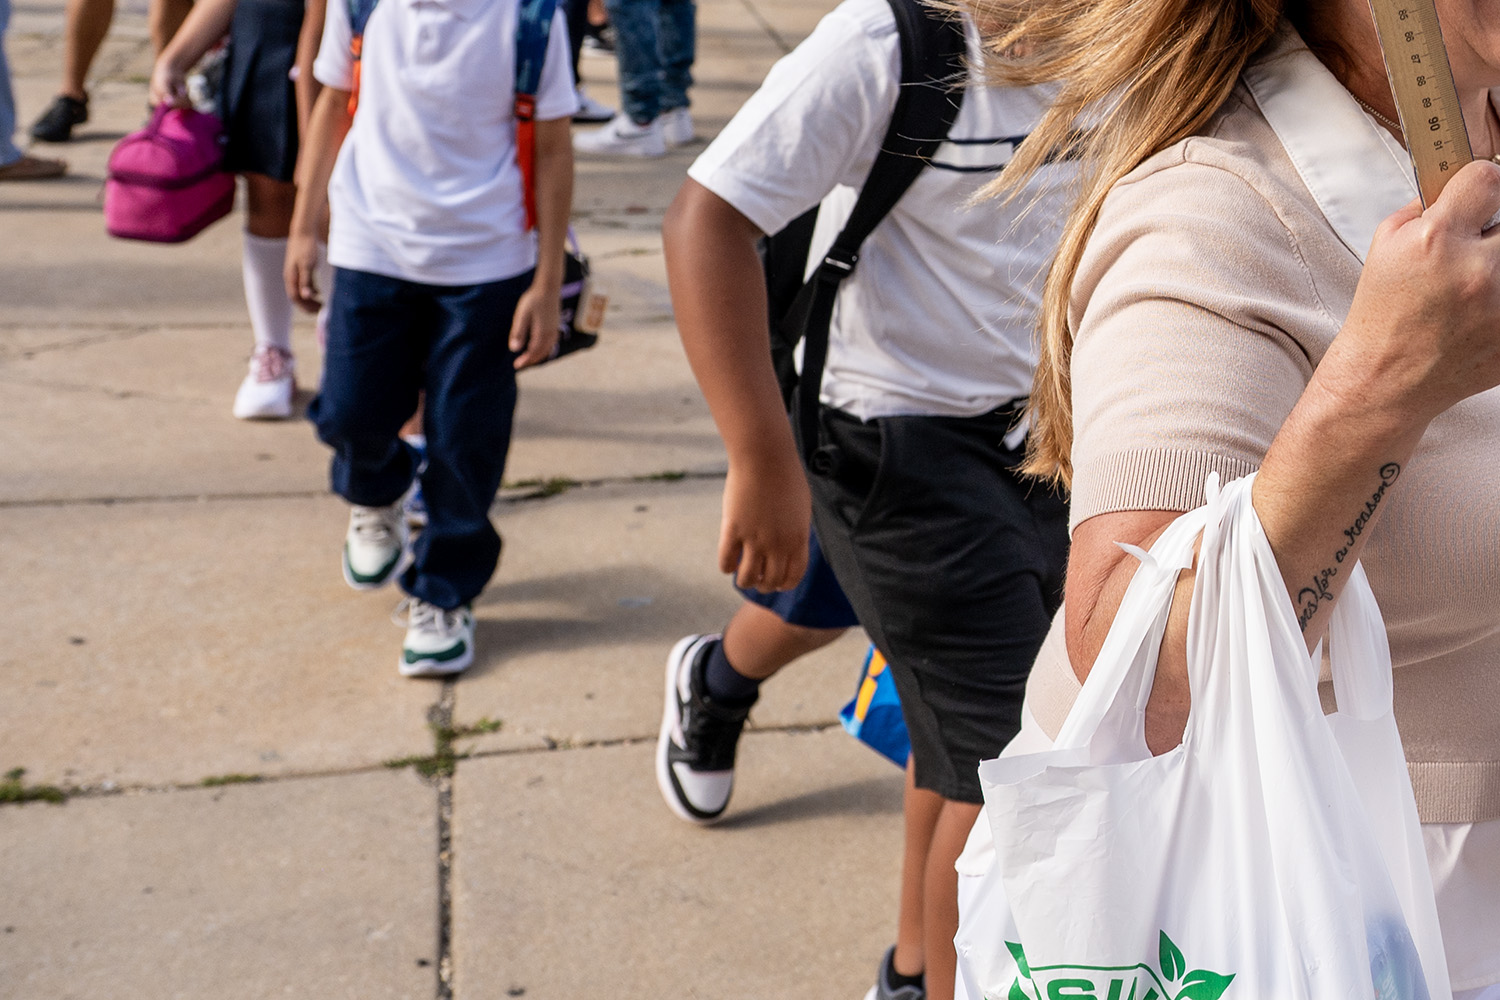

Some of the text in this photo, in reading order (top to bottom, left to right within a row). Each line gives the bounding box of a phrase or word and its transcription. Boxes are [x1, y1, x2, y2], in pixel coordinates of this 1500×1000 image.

[1398, 8, 1409, 21] 85
[1410, 53, 1421, 64] 87
[1416, 75, 1426, 87] 88
[1421, 97, 1432, 109] 89
[1428, 116, 1441, 131] 90
[1433, 139, 1444, 151] 91
[1438, 161, 1449, 172] 92
[1313, 462, 1400, 601] for a reason
